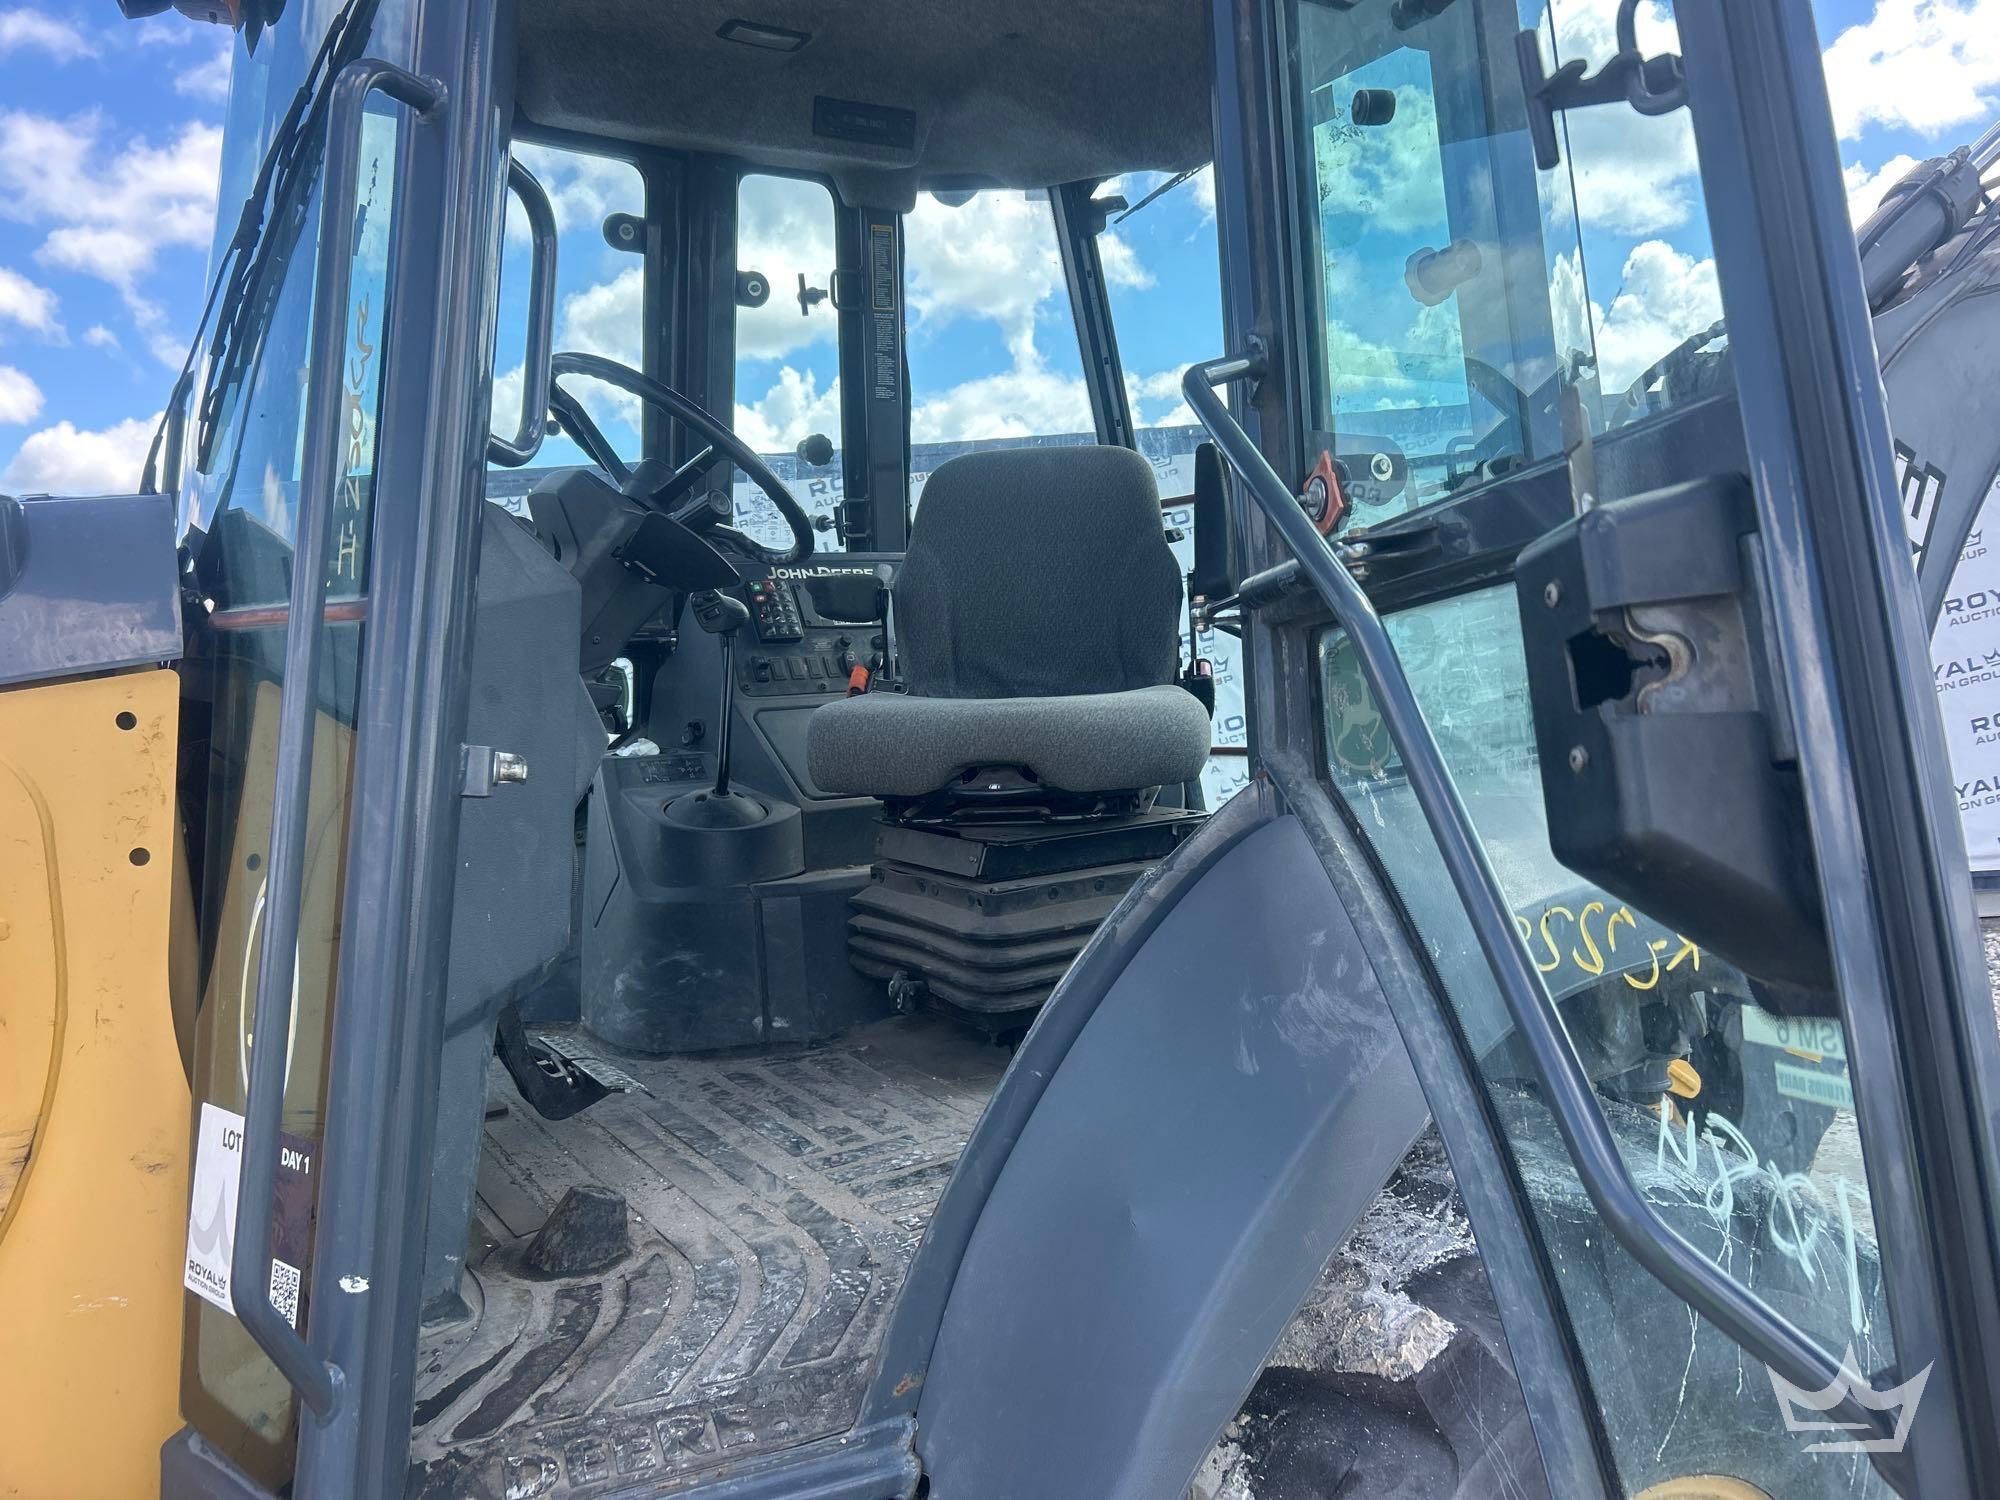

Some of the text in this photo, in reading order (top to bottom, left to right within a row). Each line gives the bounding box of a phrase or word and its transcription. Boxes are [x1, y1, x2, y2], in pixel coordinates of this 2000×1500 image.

[768, 567, 813, 580] JOHN
[1945, 589, 2000, 615] ROY
[1935, 657, 1984, 680] YAL
[1959, 670, 2000, 688] GROU
[222, 1127, 242, 1152] LOT
[281, 1147, 310, 1175] DAY 1
[188, 1273, 208, 1291] AUCTION
[189, 1259, 218, 1287] ROYAL
